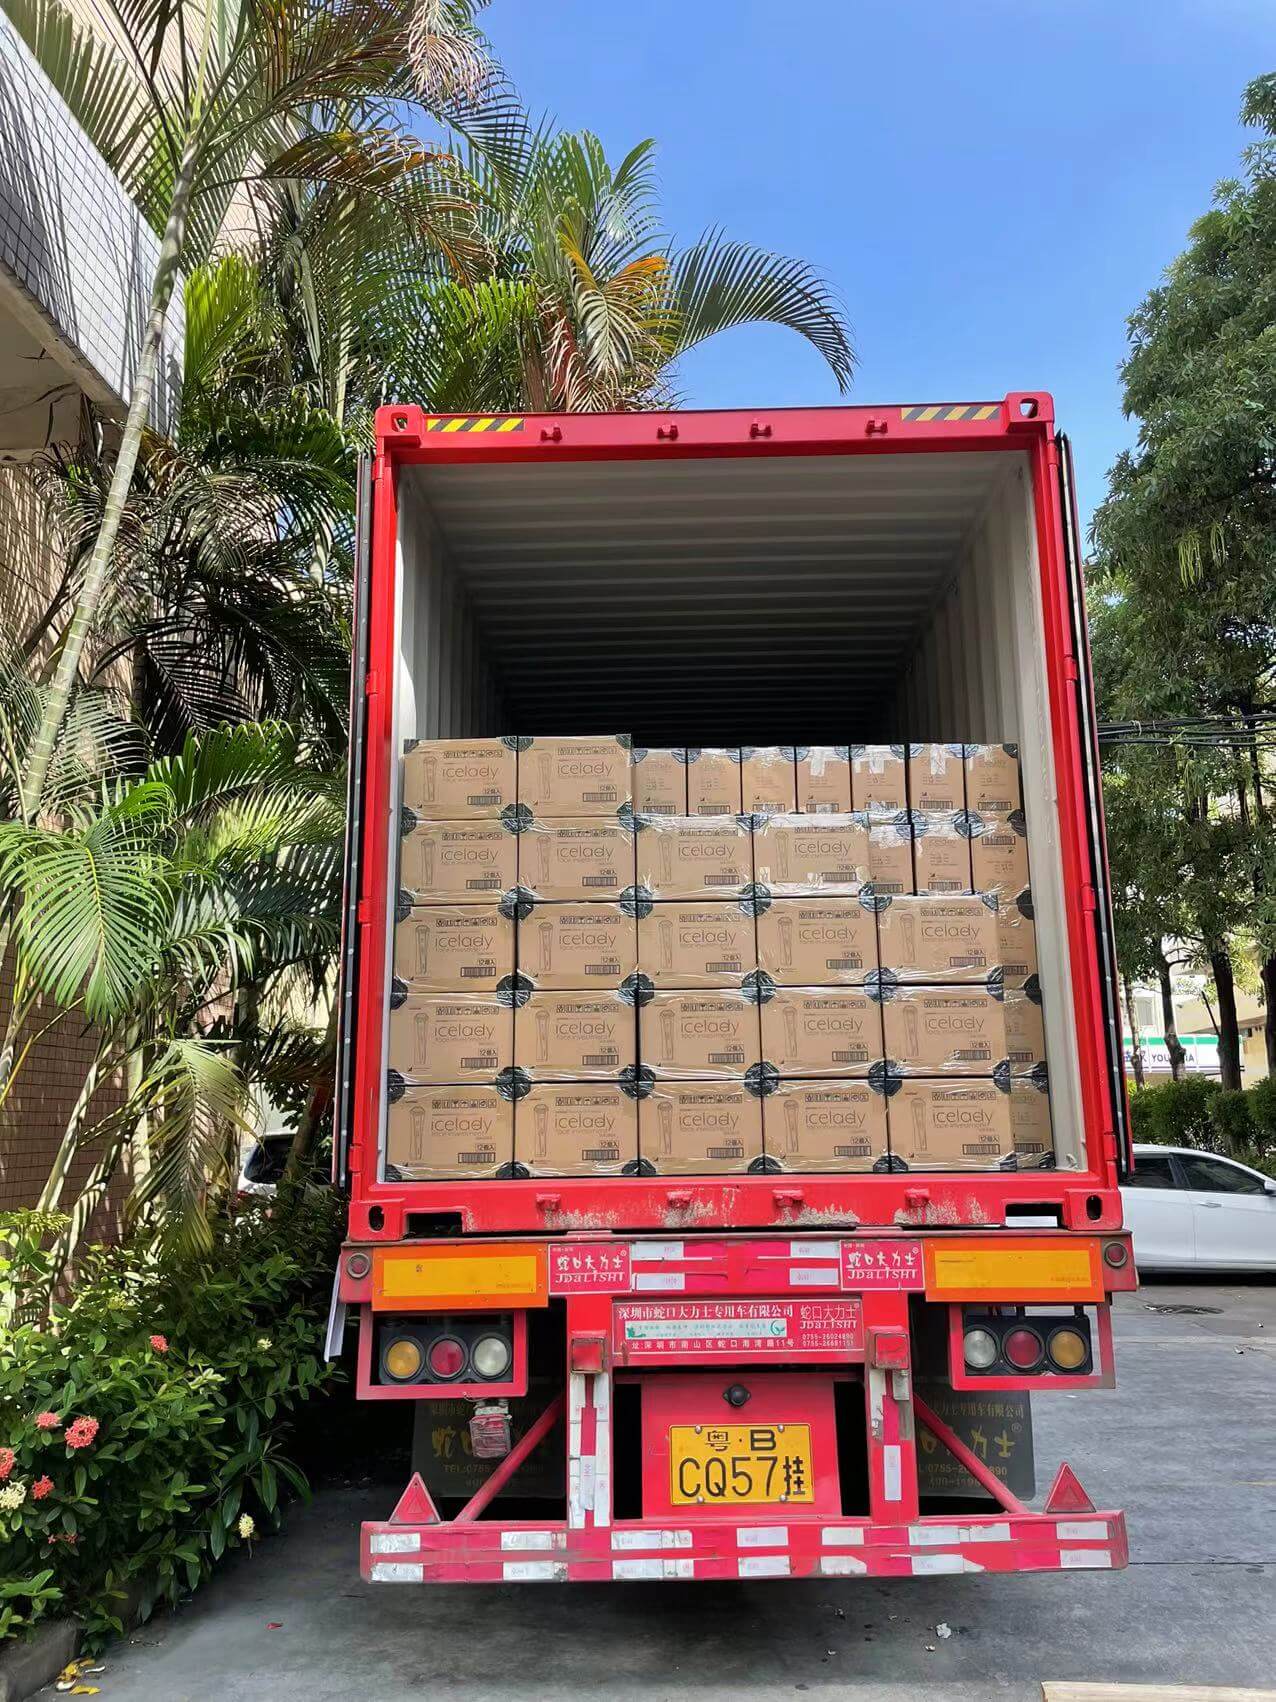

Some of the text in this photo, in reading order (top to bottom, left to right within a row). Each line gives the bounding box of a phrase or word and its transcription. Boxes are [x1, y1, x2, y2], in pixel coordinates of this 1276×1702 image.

[441, 846, 498, 862] icelady
[557, 844, 614, 860] icelady
[678, 844, 734, 858] icelady
[559, 930, 616, 946] icelady
[680, 930, 735, 945] icelady
[799, 926, 857, 942] icelady
[921, 923, 980, 939] icelady
[435, 932, 494, 947] icelady
[556, 1020, 616, 1036] icelady
[680, 1019, 739, 1035] icelady
[804, 1015, 864, 1032] icelady
[925, 1014, 984, 1030] icelady
[434, 1024, 496, 1039] icelady
[555, 1114, 615, 1130] icelady
[680, 1112, 738, 1128] icelady
[806, 1109, 866, 1126] icelady
[933, 1106, 992, 1124] icelady
[431, 1117, 492, 1133] icelady
[617, 1304, 793, 1320] 深圳市蛇口大力士专用车有限公司
[800, 1305, 857, 1320] 蛇口大力士
[679, 1456, 805, 1497] CQ57挂
